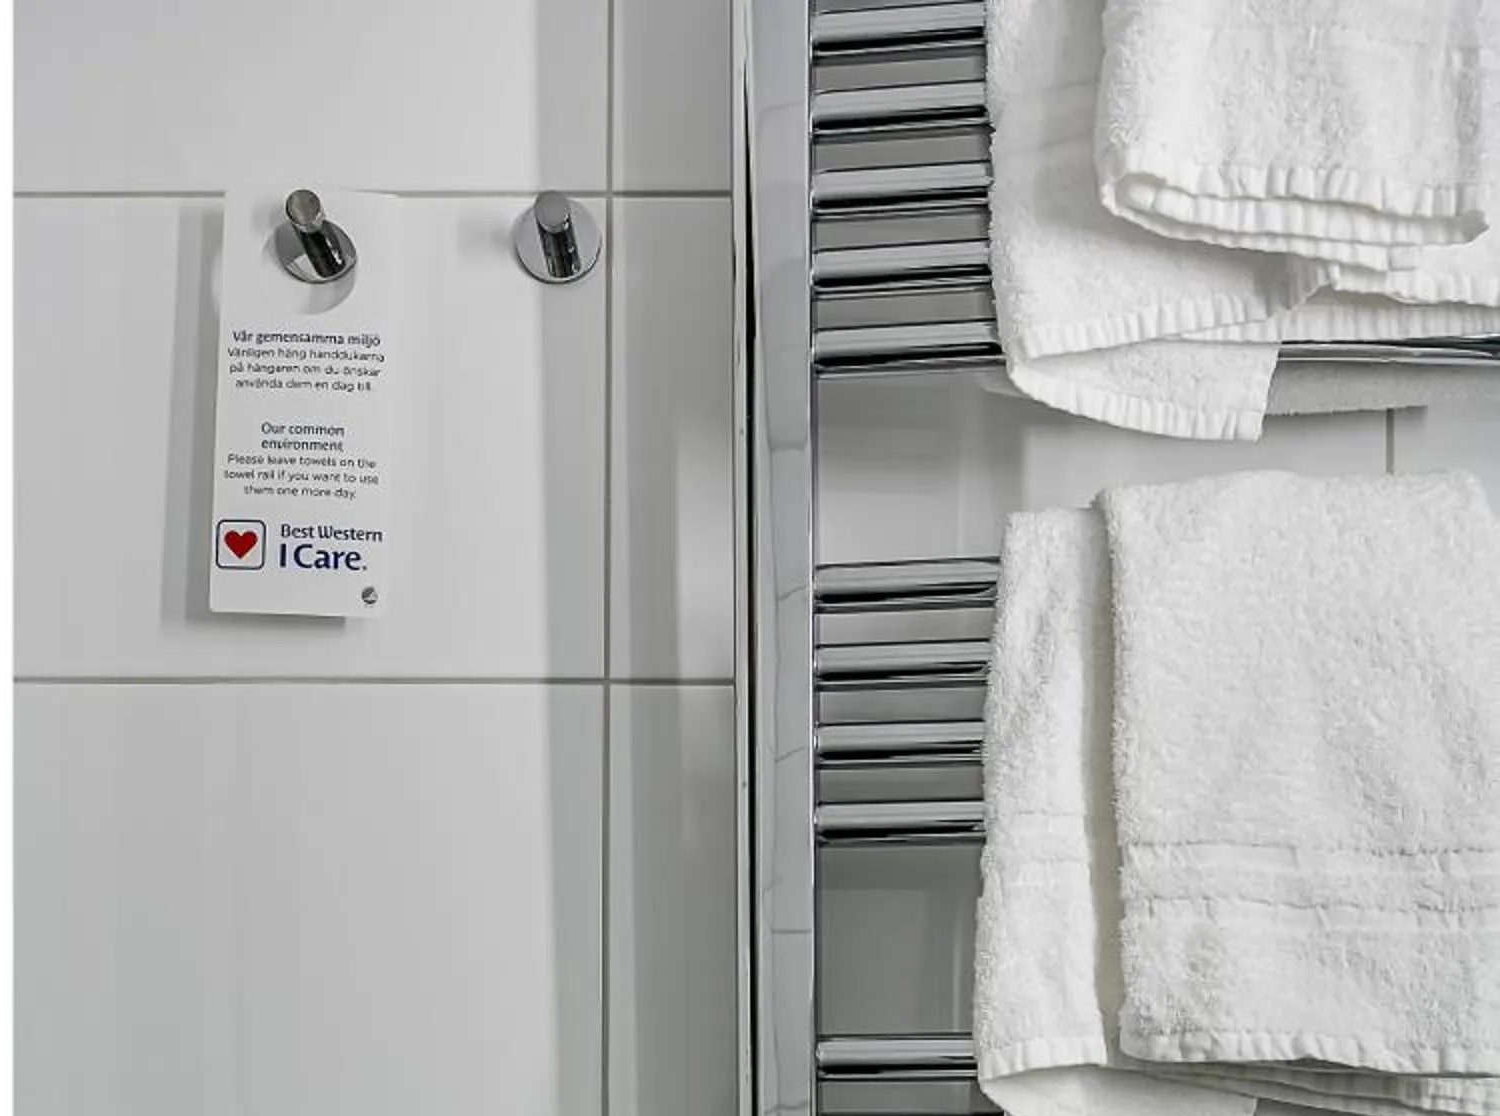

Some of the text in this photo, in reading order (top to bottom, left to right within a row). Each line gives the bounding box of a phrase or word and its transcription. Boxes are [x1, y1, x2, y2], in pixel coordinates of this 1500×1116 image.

[261, 421, 345, 437] Our common
[261, 438, 344, 452] environment
[281, 523, 383, 542] Best Western
[279, 543, 368, 571] I Care.
